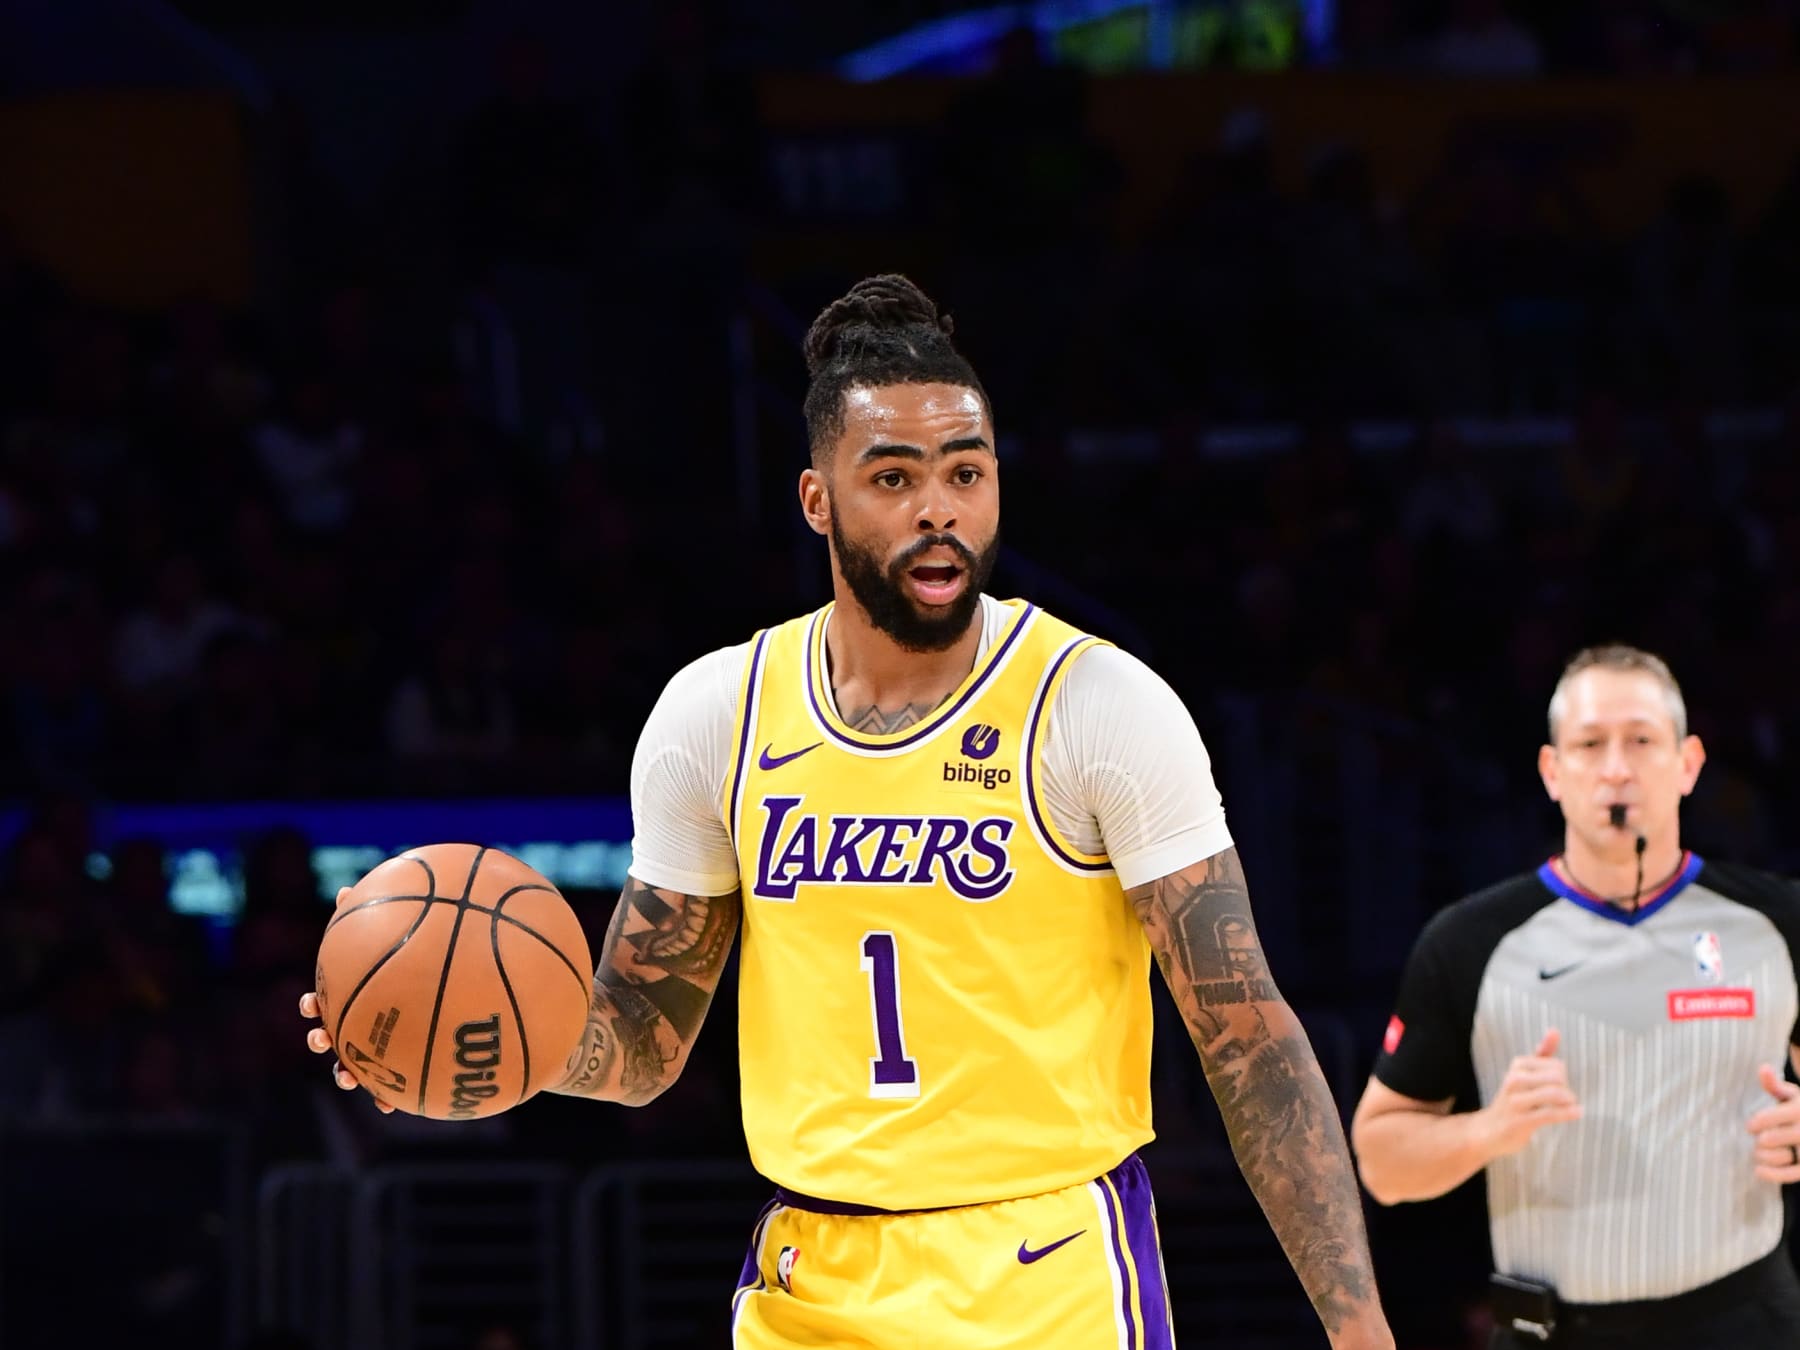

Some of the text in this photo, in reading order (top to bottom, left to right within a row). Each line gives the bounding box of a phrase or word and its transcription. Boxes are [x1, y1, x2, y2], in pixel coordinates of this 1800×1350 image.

[942, 761, 1012, 790] bibigo
[753, 793, 1015, 904] LAKERS
[448, 1013, 501, 1120] Wilso
[859, 929, 921, 1099] 1
